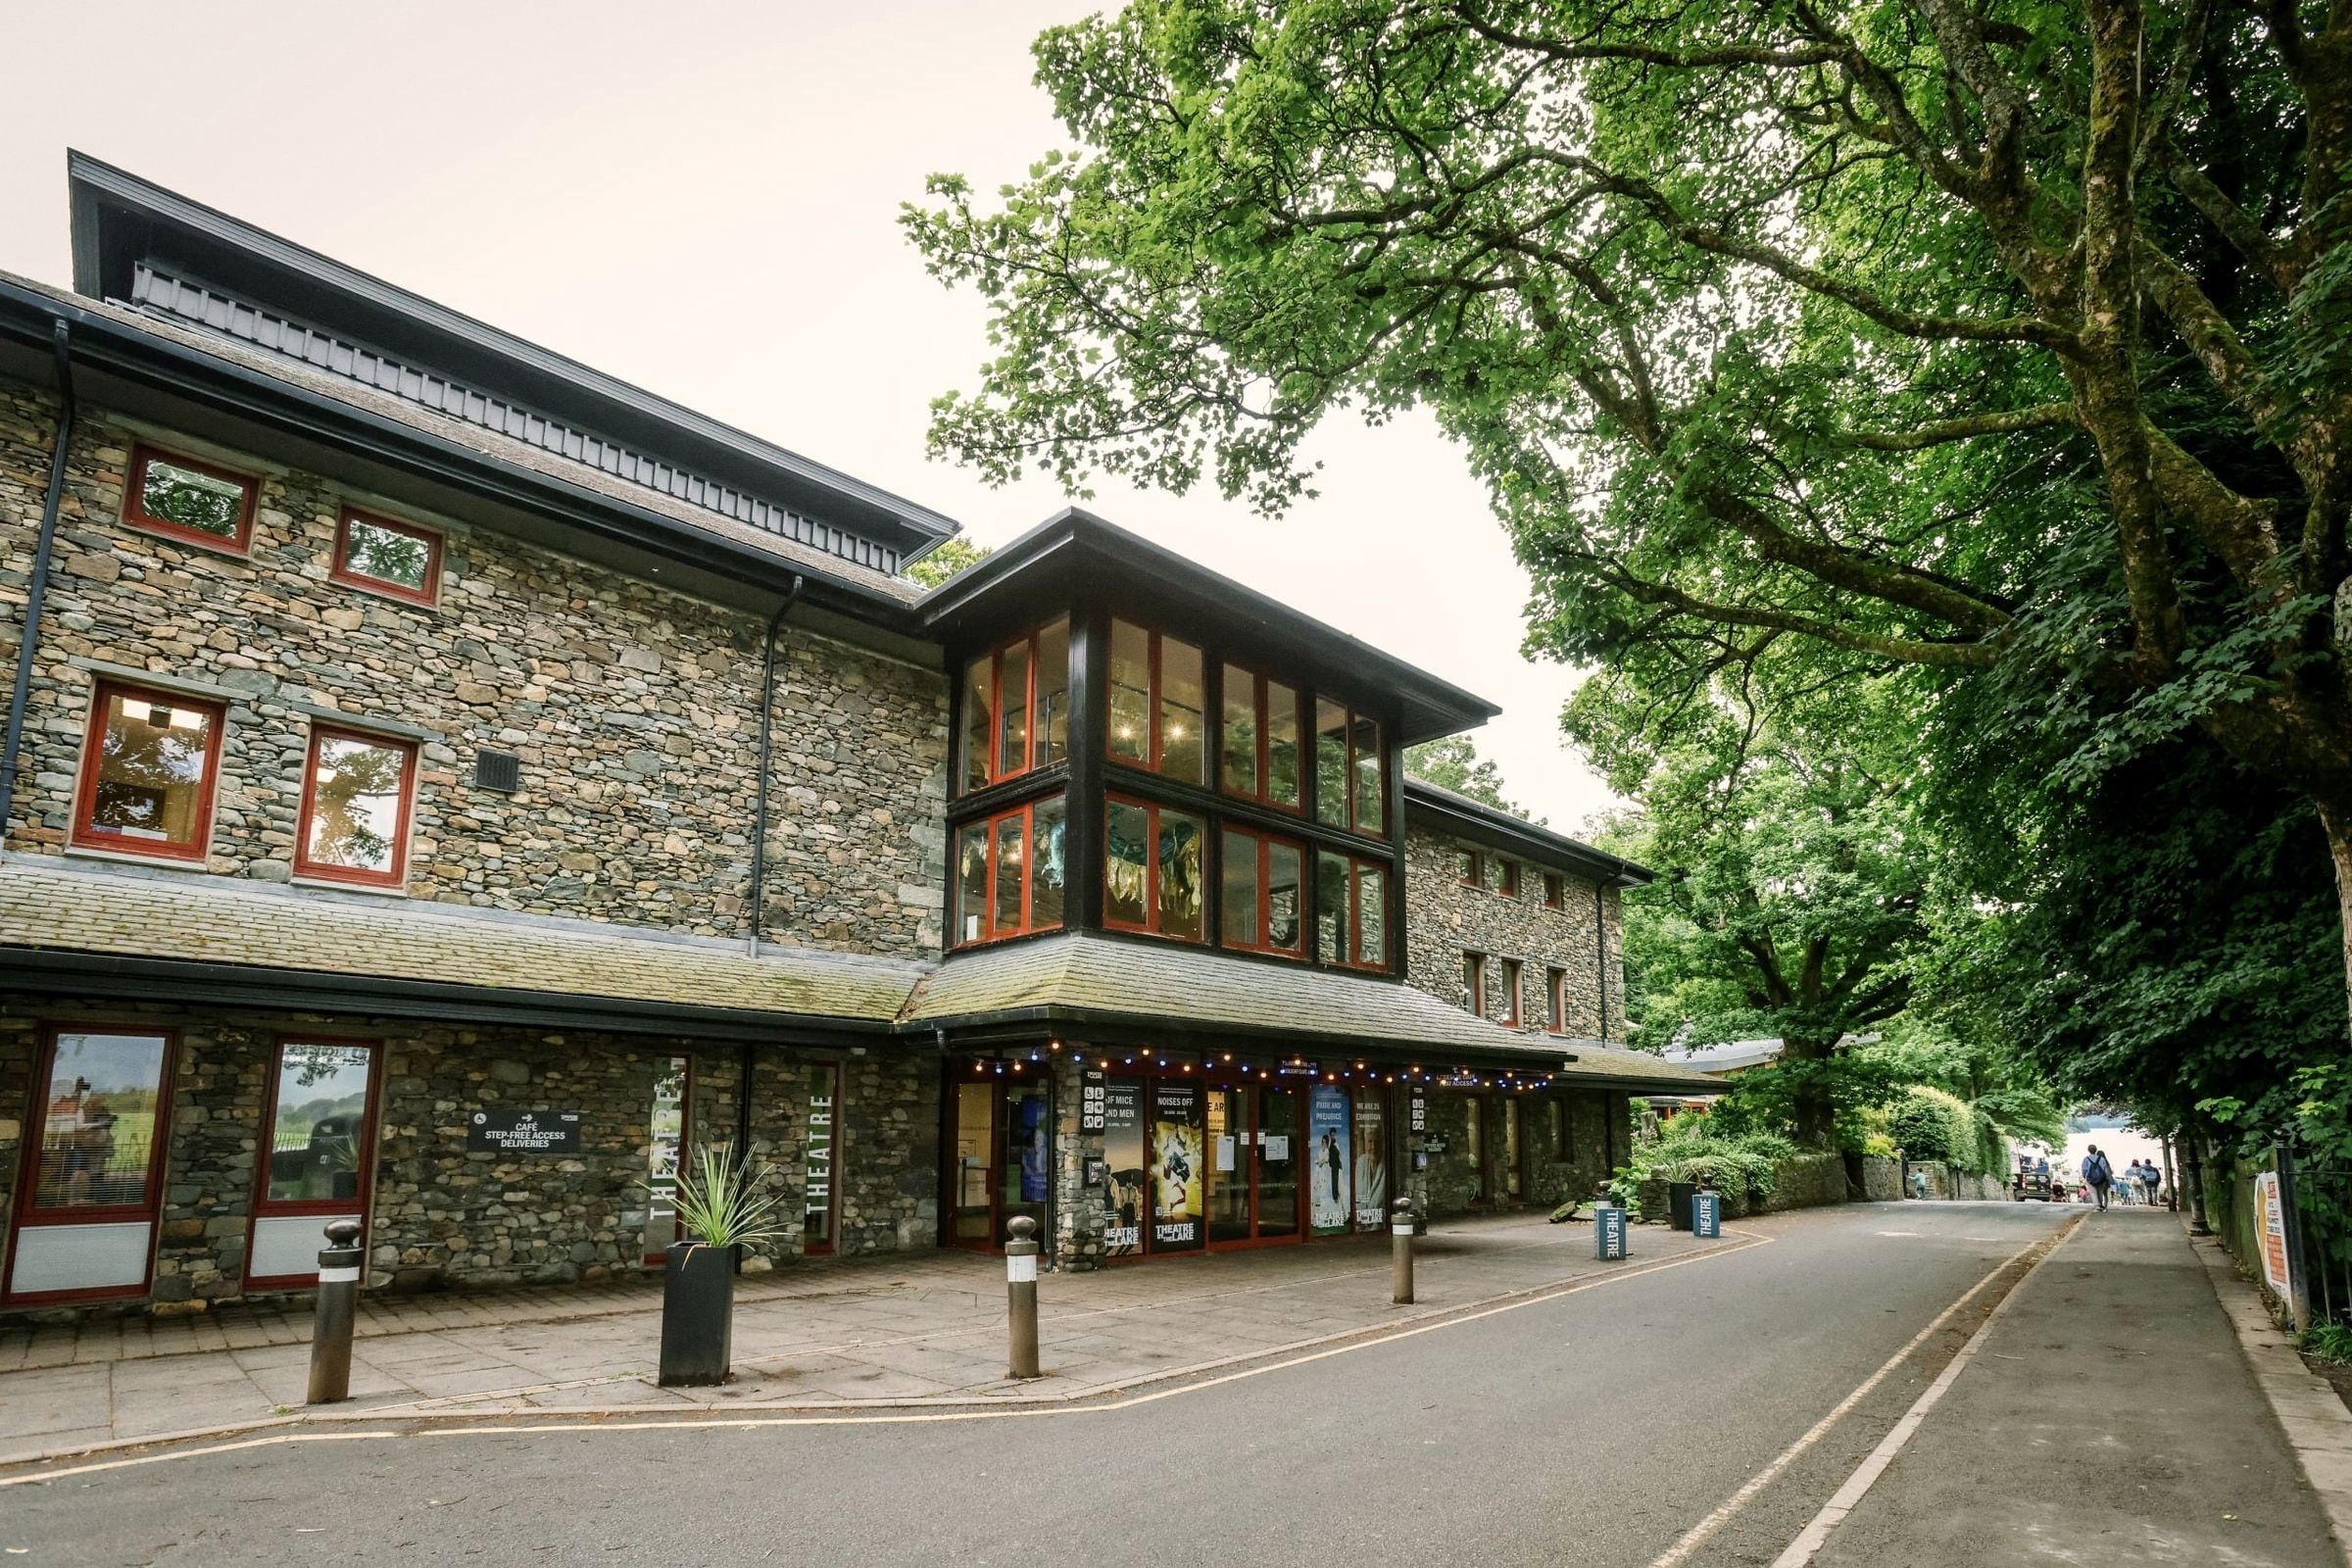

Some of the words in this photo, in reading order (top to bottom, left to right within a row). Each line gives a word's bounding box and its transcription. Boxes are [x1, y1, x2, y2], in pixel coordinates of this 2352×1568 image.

[1115, 1096, 1134, 1105] MICE
[1158, 1097, 1181, 1106] NOISES
[1182, 1098, 1194, 1106] OFF
[1214, 1102, 1224, 1112] AR
[1106, 1108, 1118, 1117] ND
[1119, 1108, 1135, 1118] MEN
[515, 1121, 538, 1132] CAFÉ
[531, 1131, 565, 1140] ACCESS
[501, 1139, 550, 1148] DELIVERIES
[650, 1089, 682, 1220] THEATRE
[807, 1096, 831, 1215] THEATRE
[1700, 1198, 1712, 1235] THEATRE
[1104, 1227, 1139, 1238] HEATRE
[1155, 1223, 1195, 1235] THEATRE
[1607, 1210, 1618, 1257] THEATRE
[1114, 1234, 1139, 1247] LAKE
[1172, 1231, 1195, 1242] LAKE
